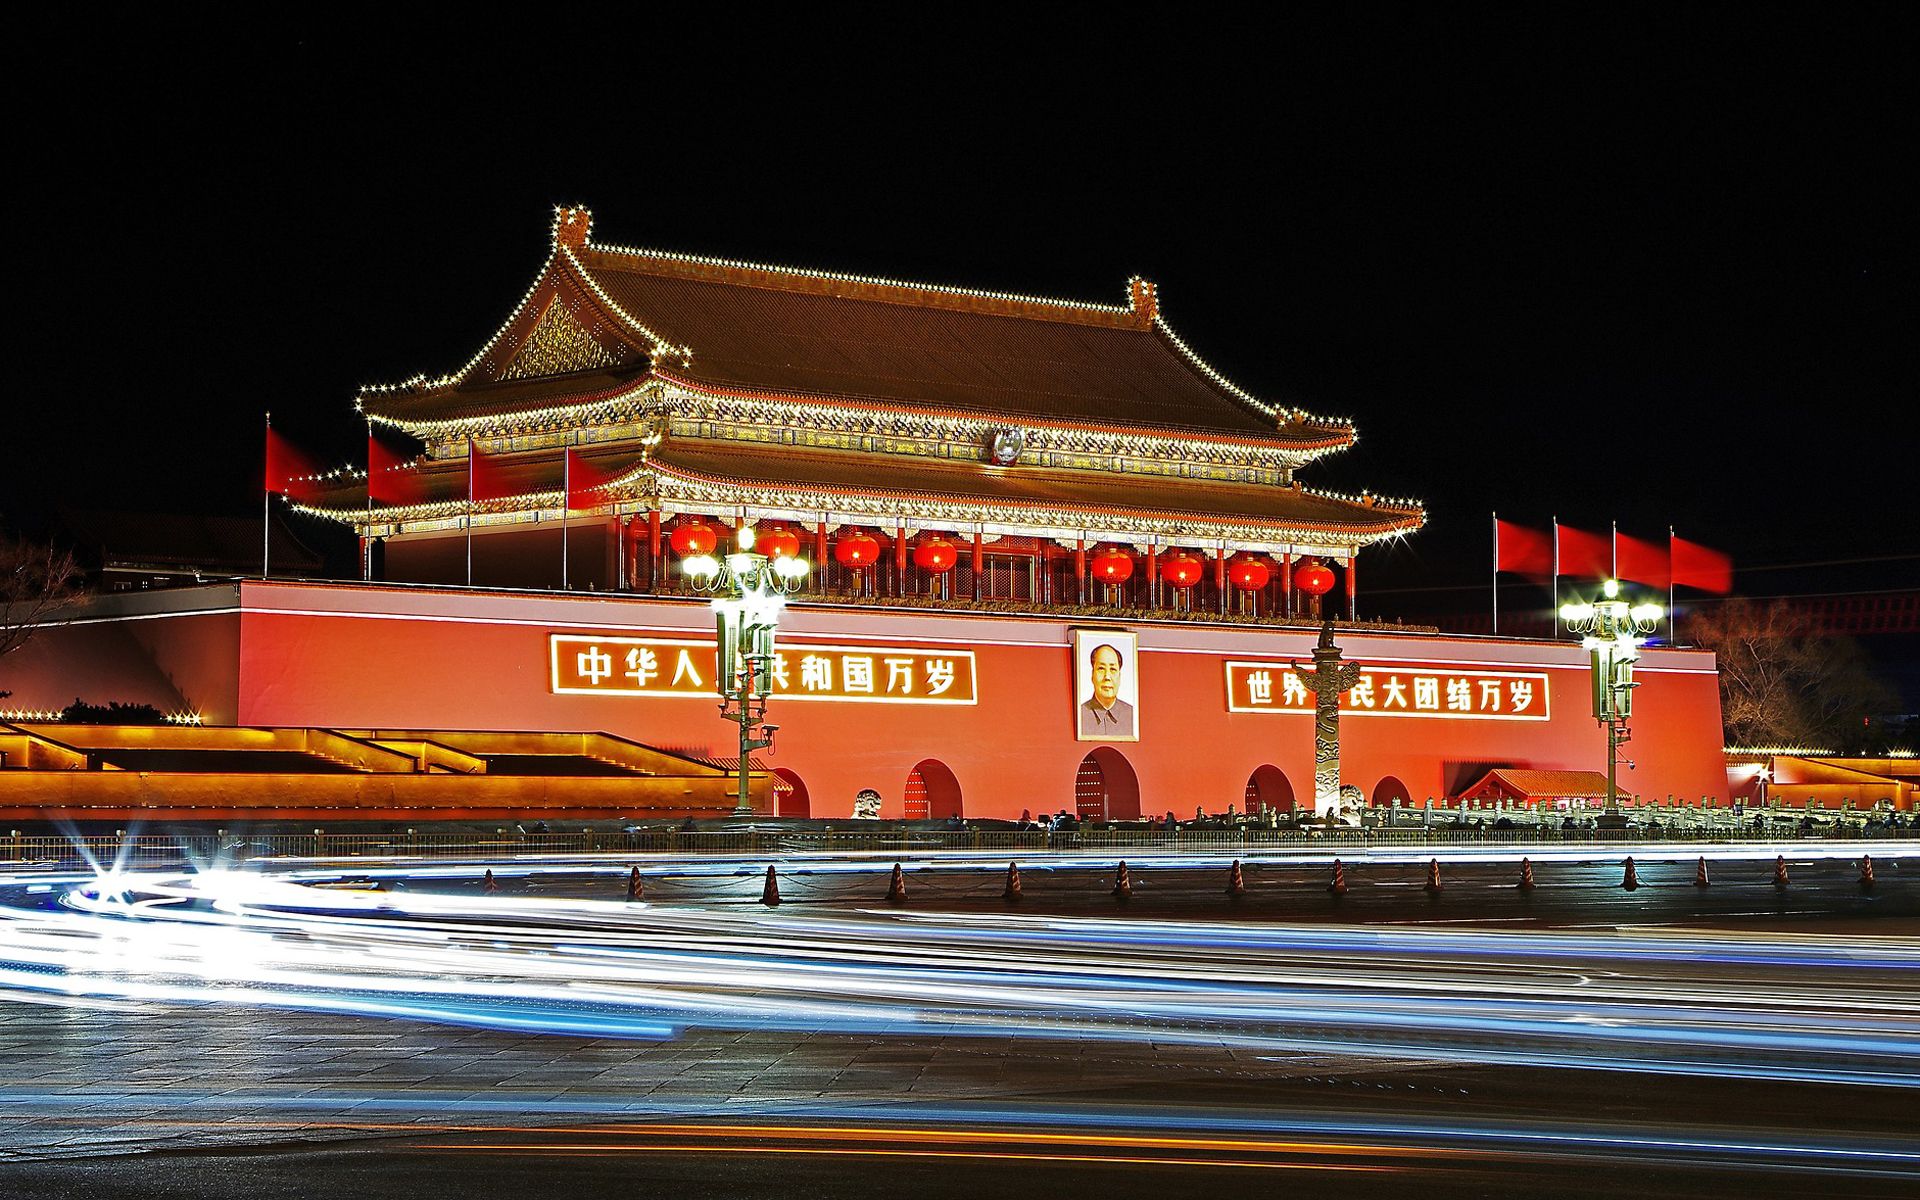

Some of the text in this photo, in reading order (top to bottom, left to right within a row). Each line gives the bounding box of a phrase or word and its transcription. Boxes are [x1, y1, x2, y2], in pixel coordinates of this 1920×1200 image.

[577, 646, 955, 695] 中华人共和国万岁
[1246, 671, 1533, 712] 世界民大团结万岁
